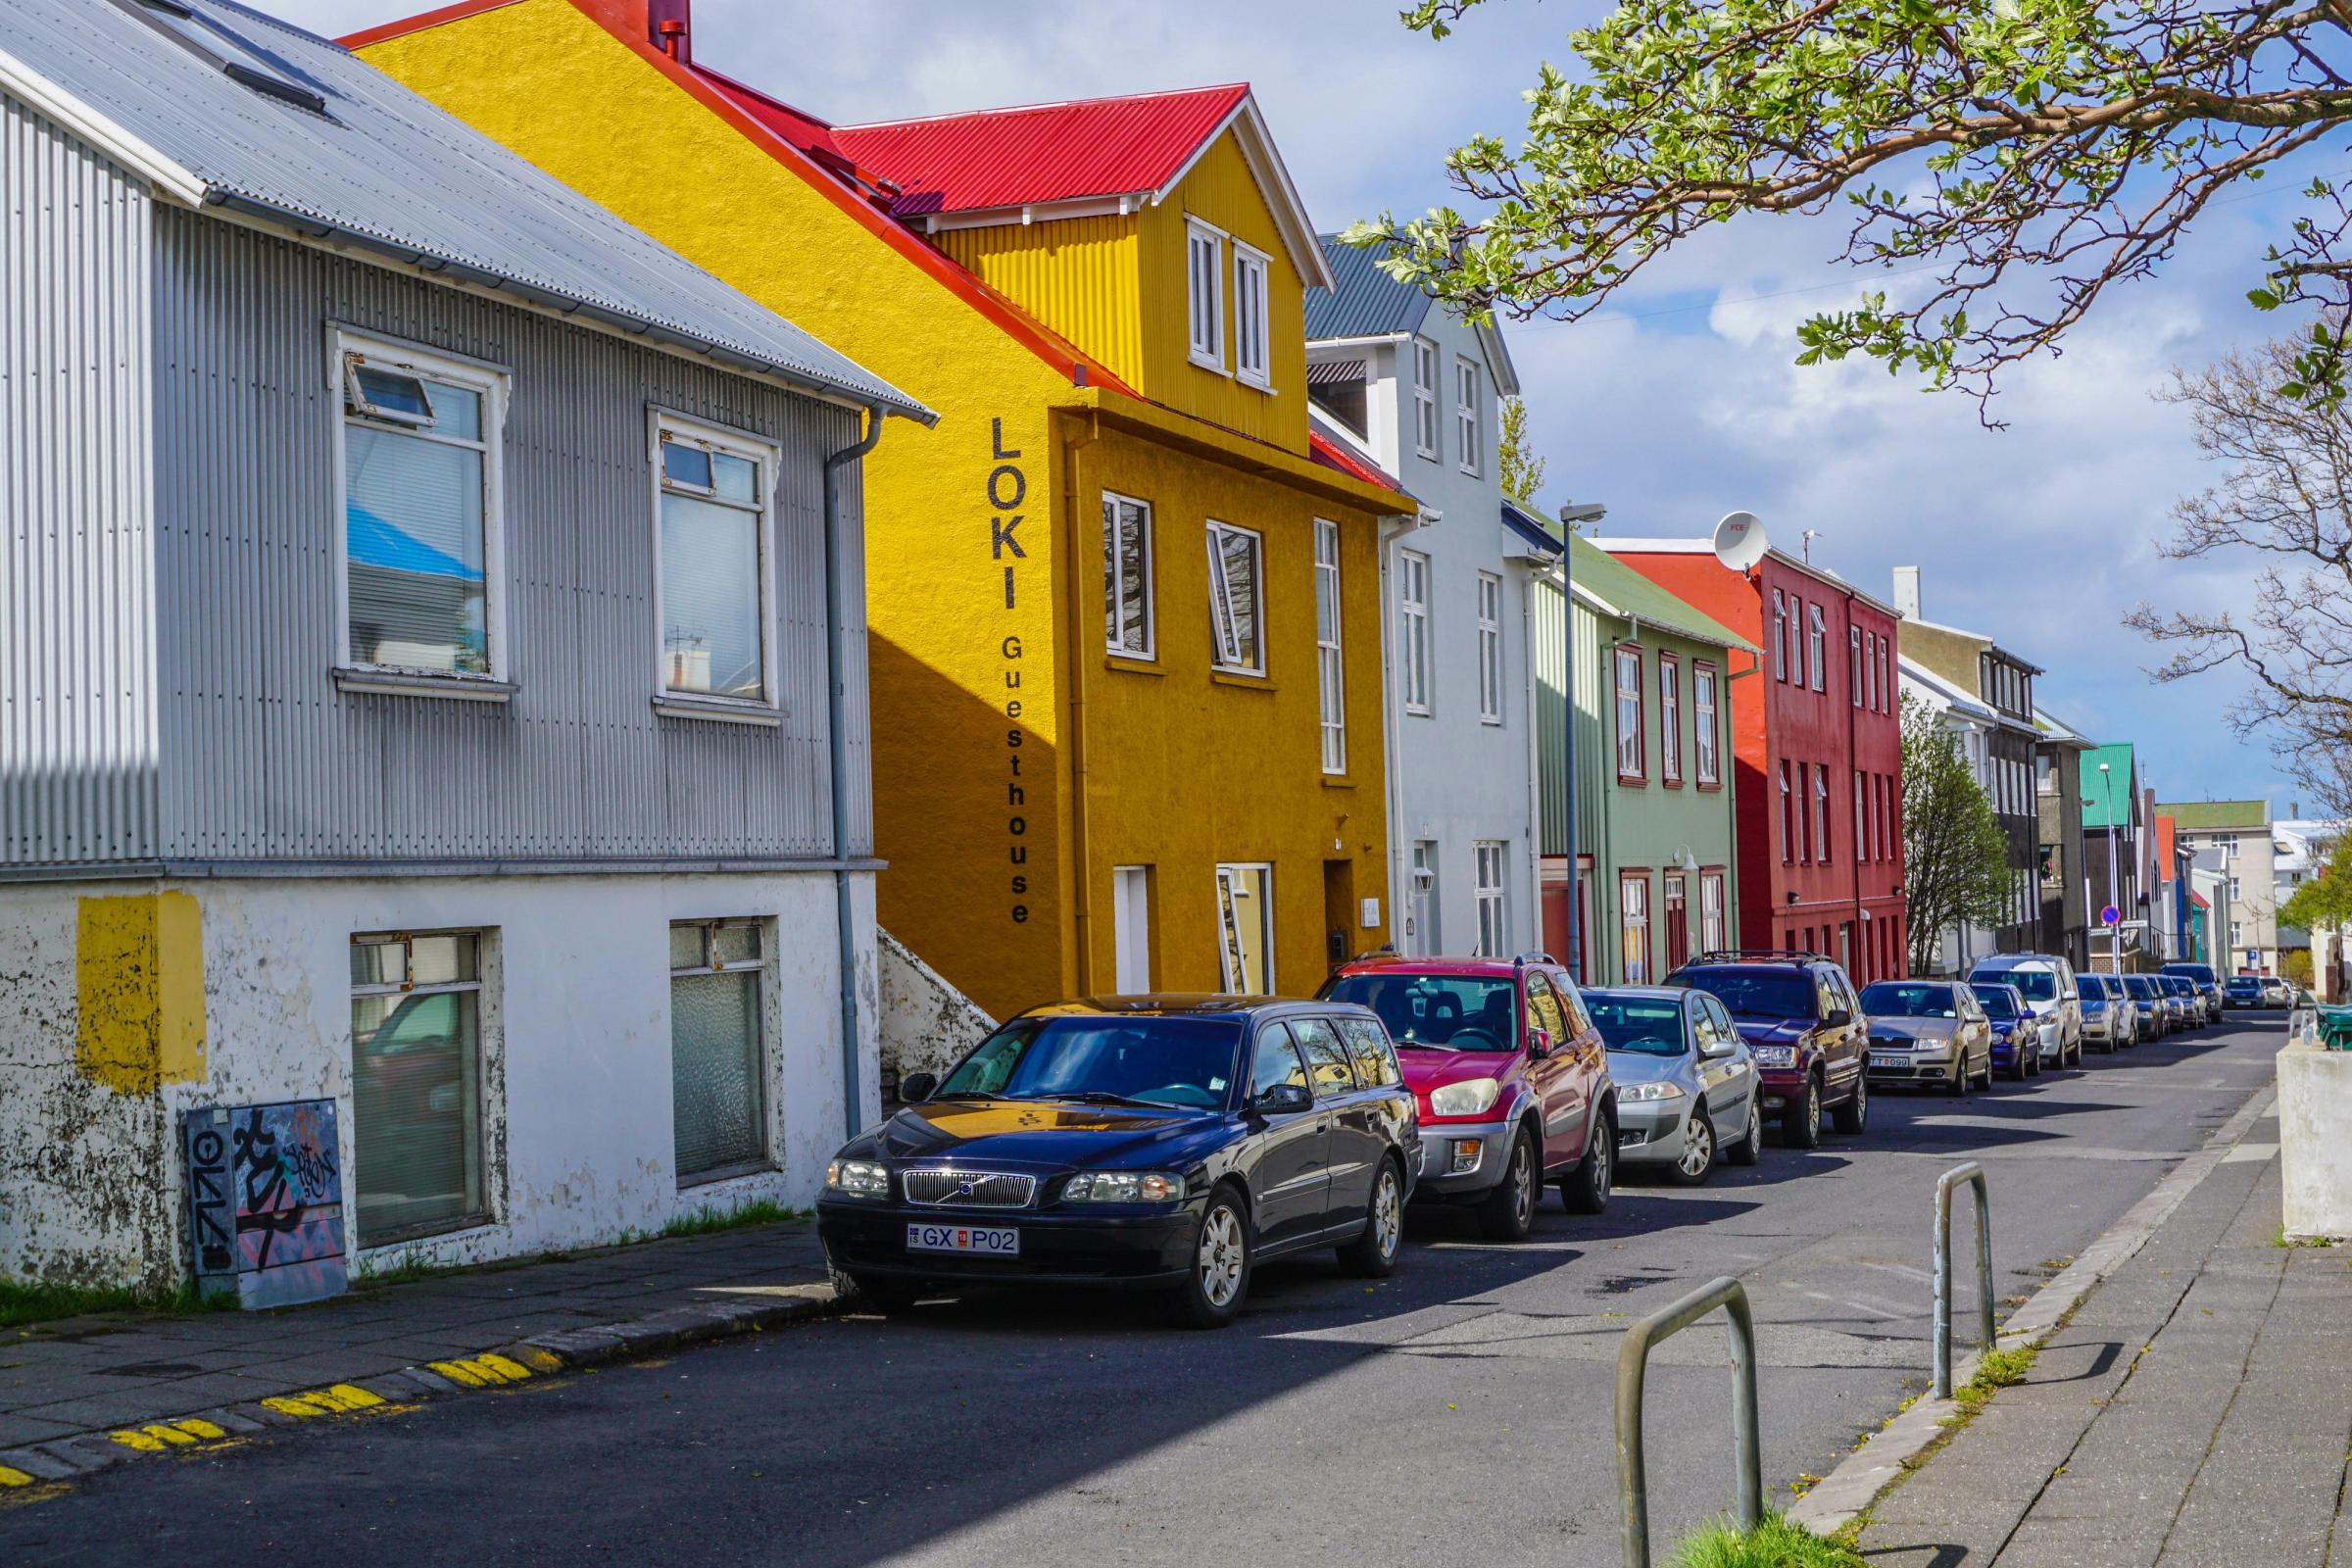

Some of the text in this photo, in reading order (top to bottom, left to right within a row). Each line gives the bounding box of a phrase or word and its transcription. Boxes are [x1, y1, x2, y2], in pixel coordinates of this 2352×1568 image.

[987, 416, 1028, 924] LOKI Guesthouse
[923, 1228, 1015, 1250] GX P02
